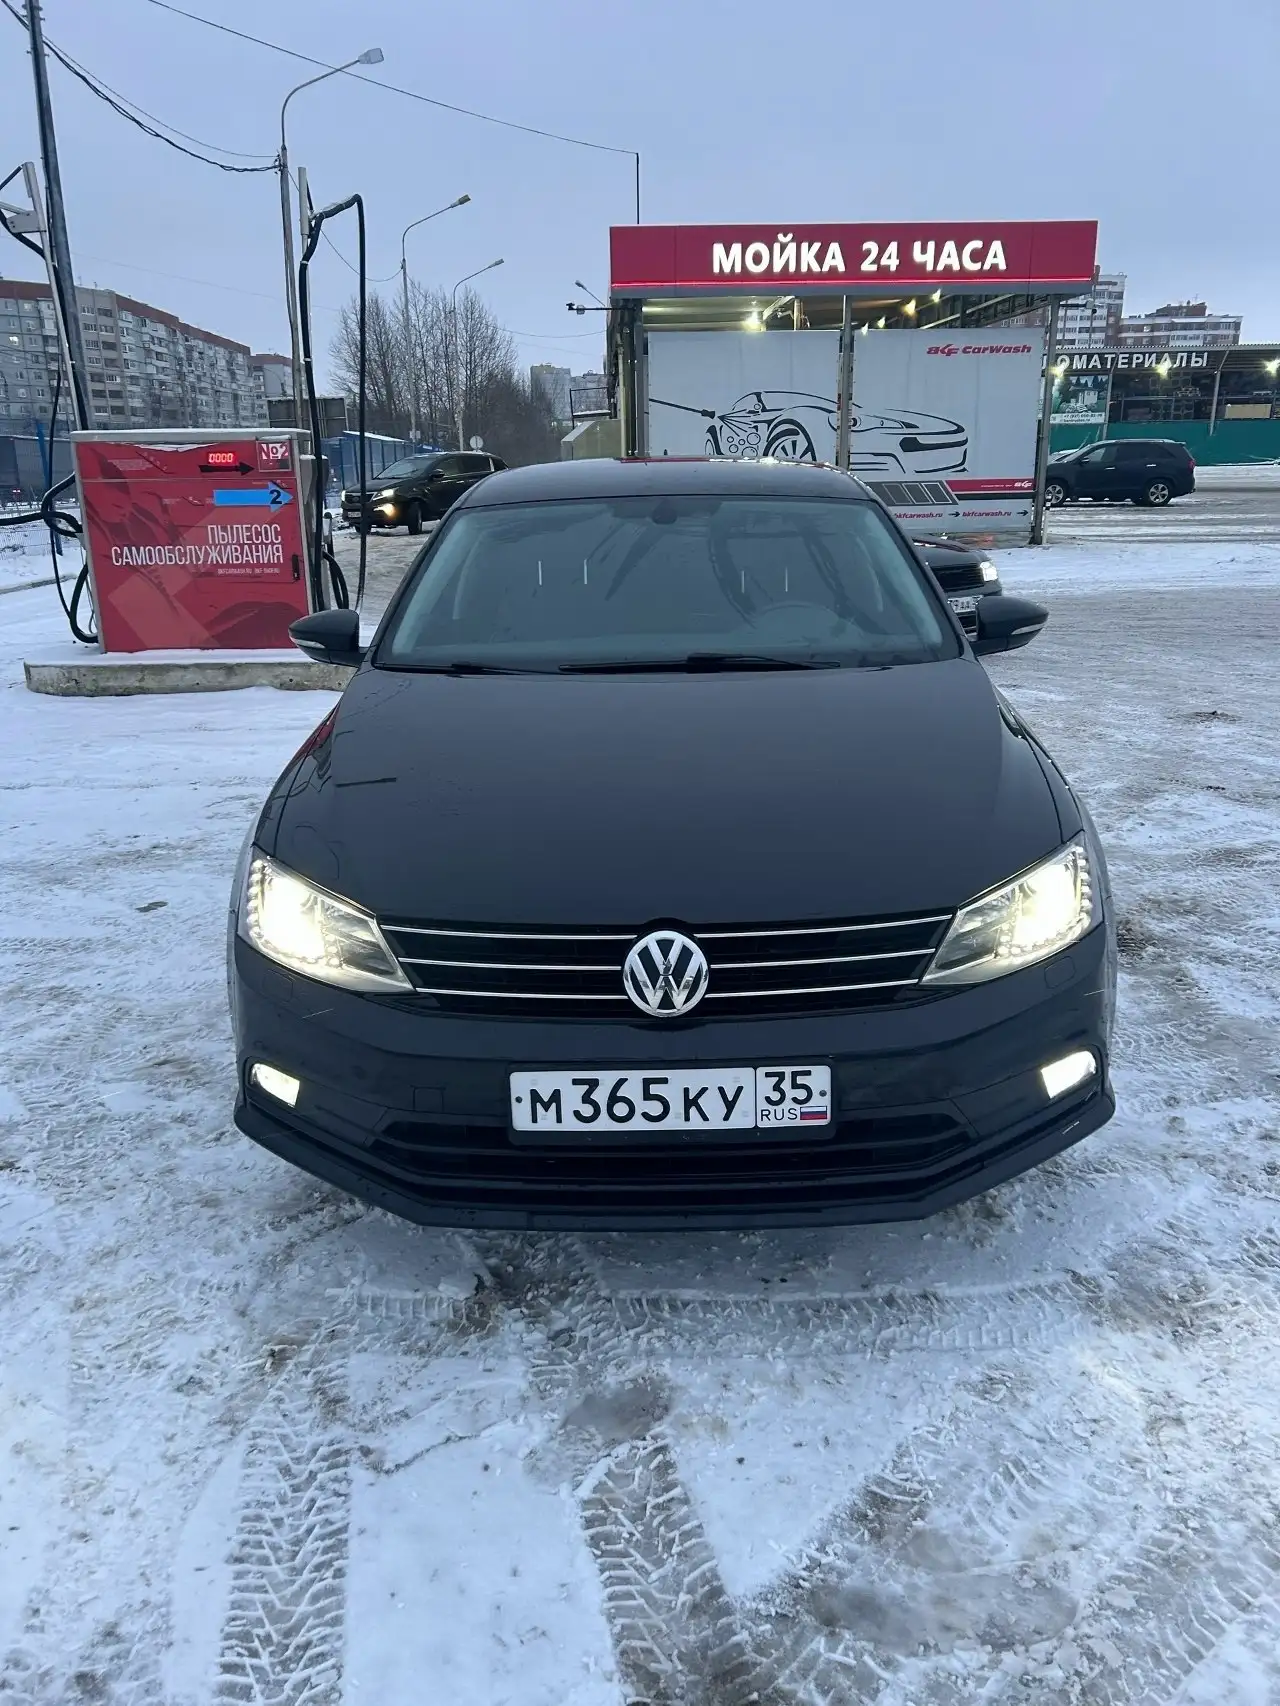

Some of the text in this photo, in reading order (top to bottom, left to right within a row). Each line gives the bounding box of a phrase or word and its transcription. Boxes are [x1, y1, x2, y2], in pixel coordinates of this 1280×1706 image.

[712, 233, 1007, 273] МОЙКА 24 ЧАСА
[961, 344, 1032, 354] CarWash
[269, 489, 283, 505] 2
[207, 524, 282, 544] ПЫЛЕСОС
[111, 545, 284, 566] САМООБСЛУЖИВАНИЯ
[530, 1070, 813, 1124] М365КУ 35
[760, 1108, 798, 1121] RUS
